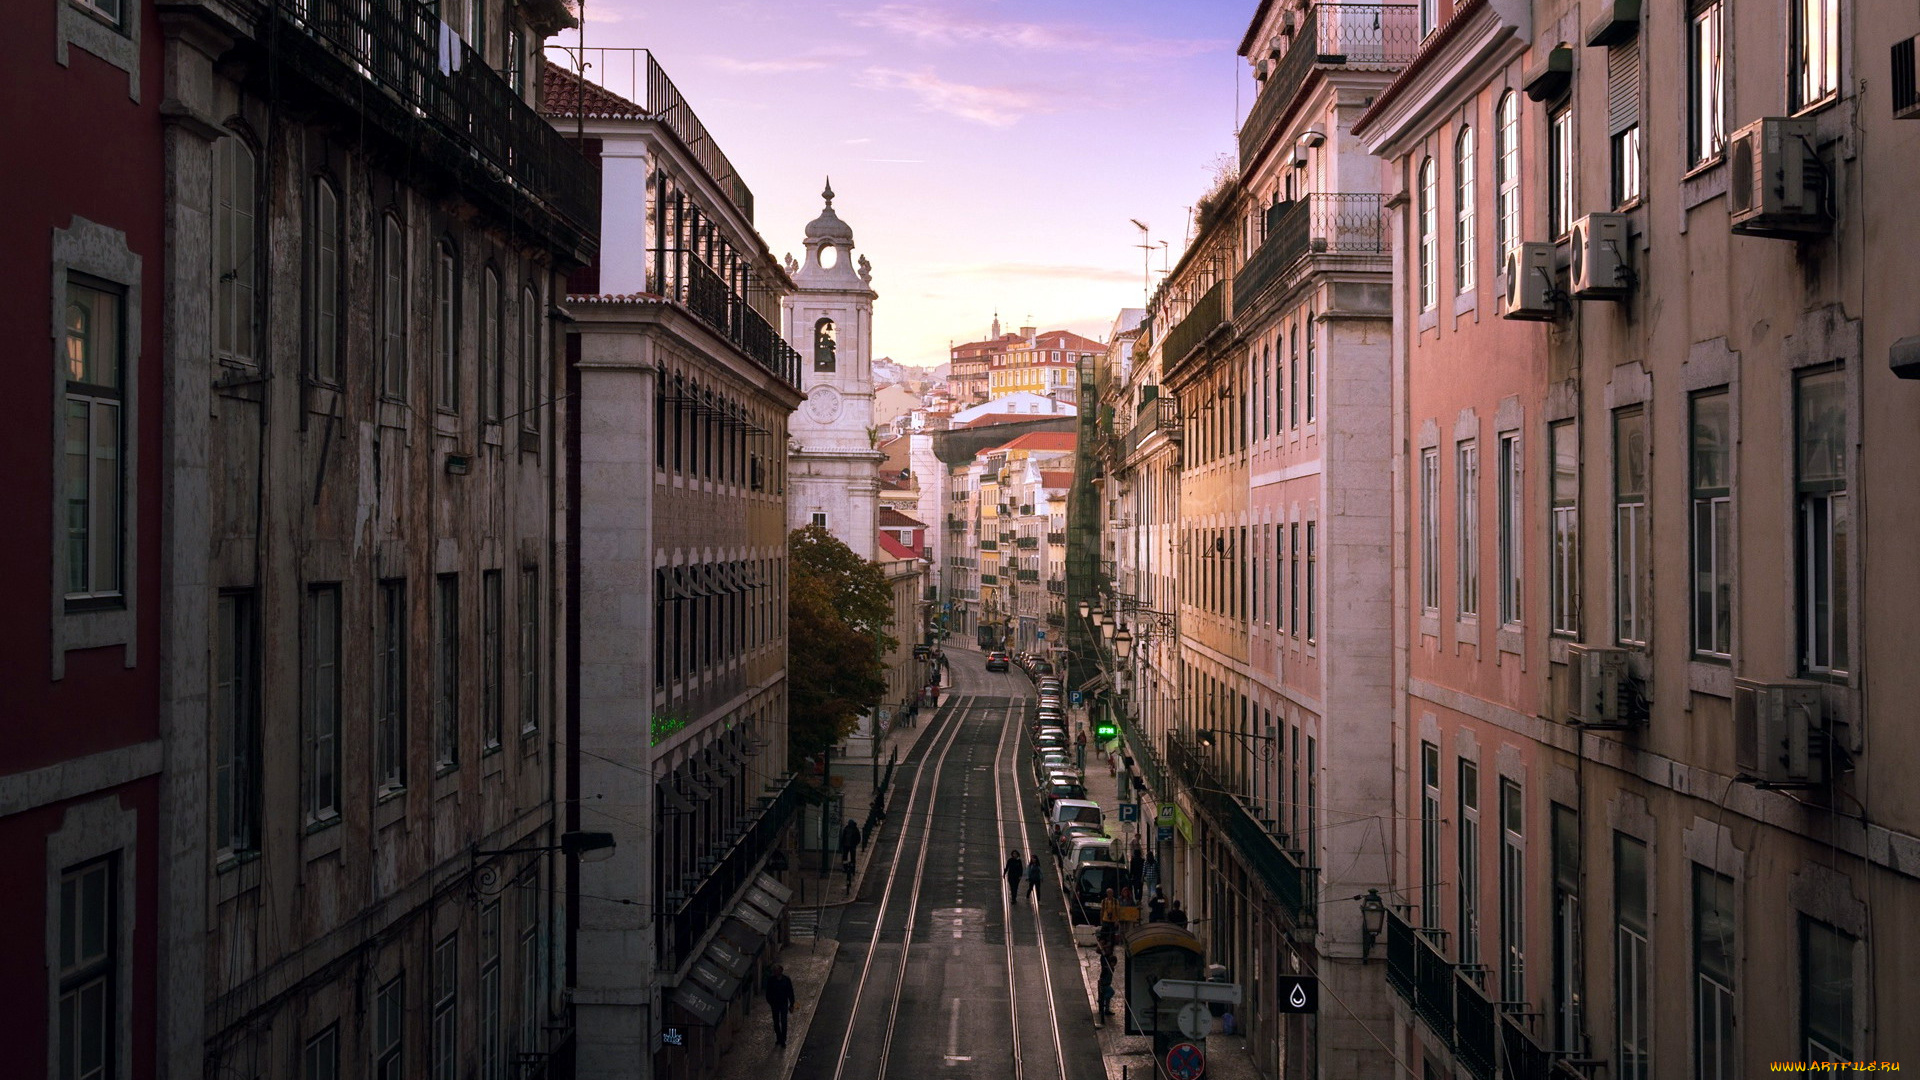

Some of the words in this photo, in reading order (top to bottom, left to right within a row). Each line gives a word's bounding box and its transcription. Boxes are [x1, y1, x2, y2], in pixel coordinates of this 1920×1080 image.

[1072, 692, 1080, 702] P
[1123, 806, 1133, 820] P
[1162, 806, 1173, 817] M
